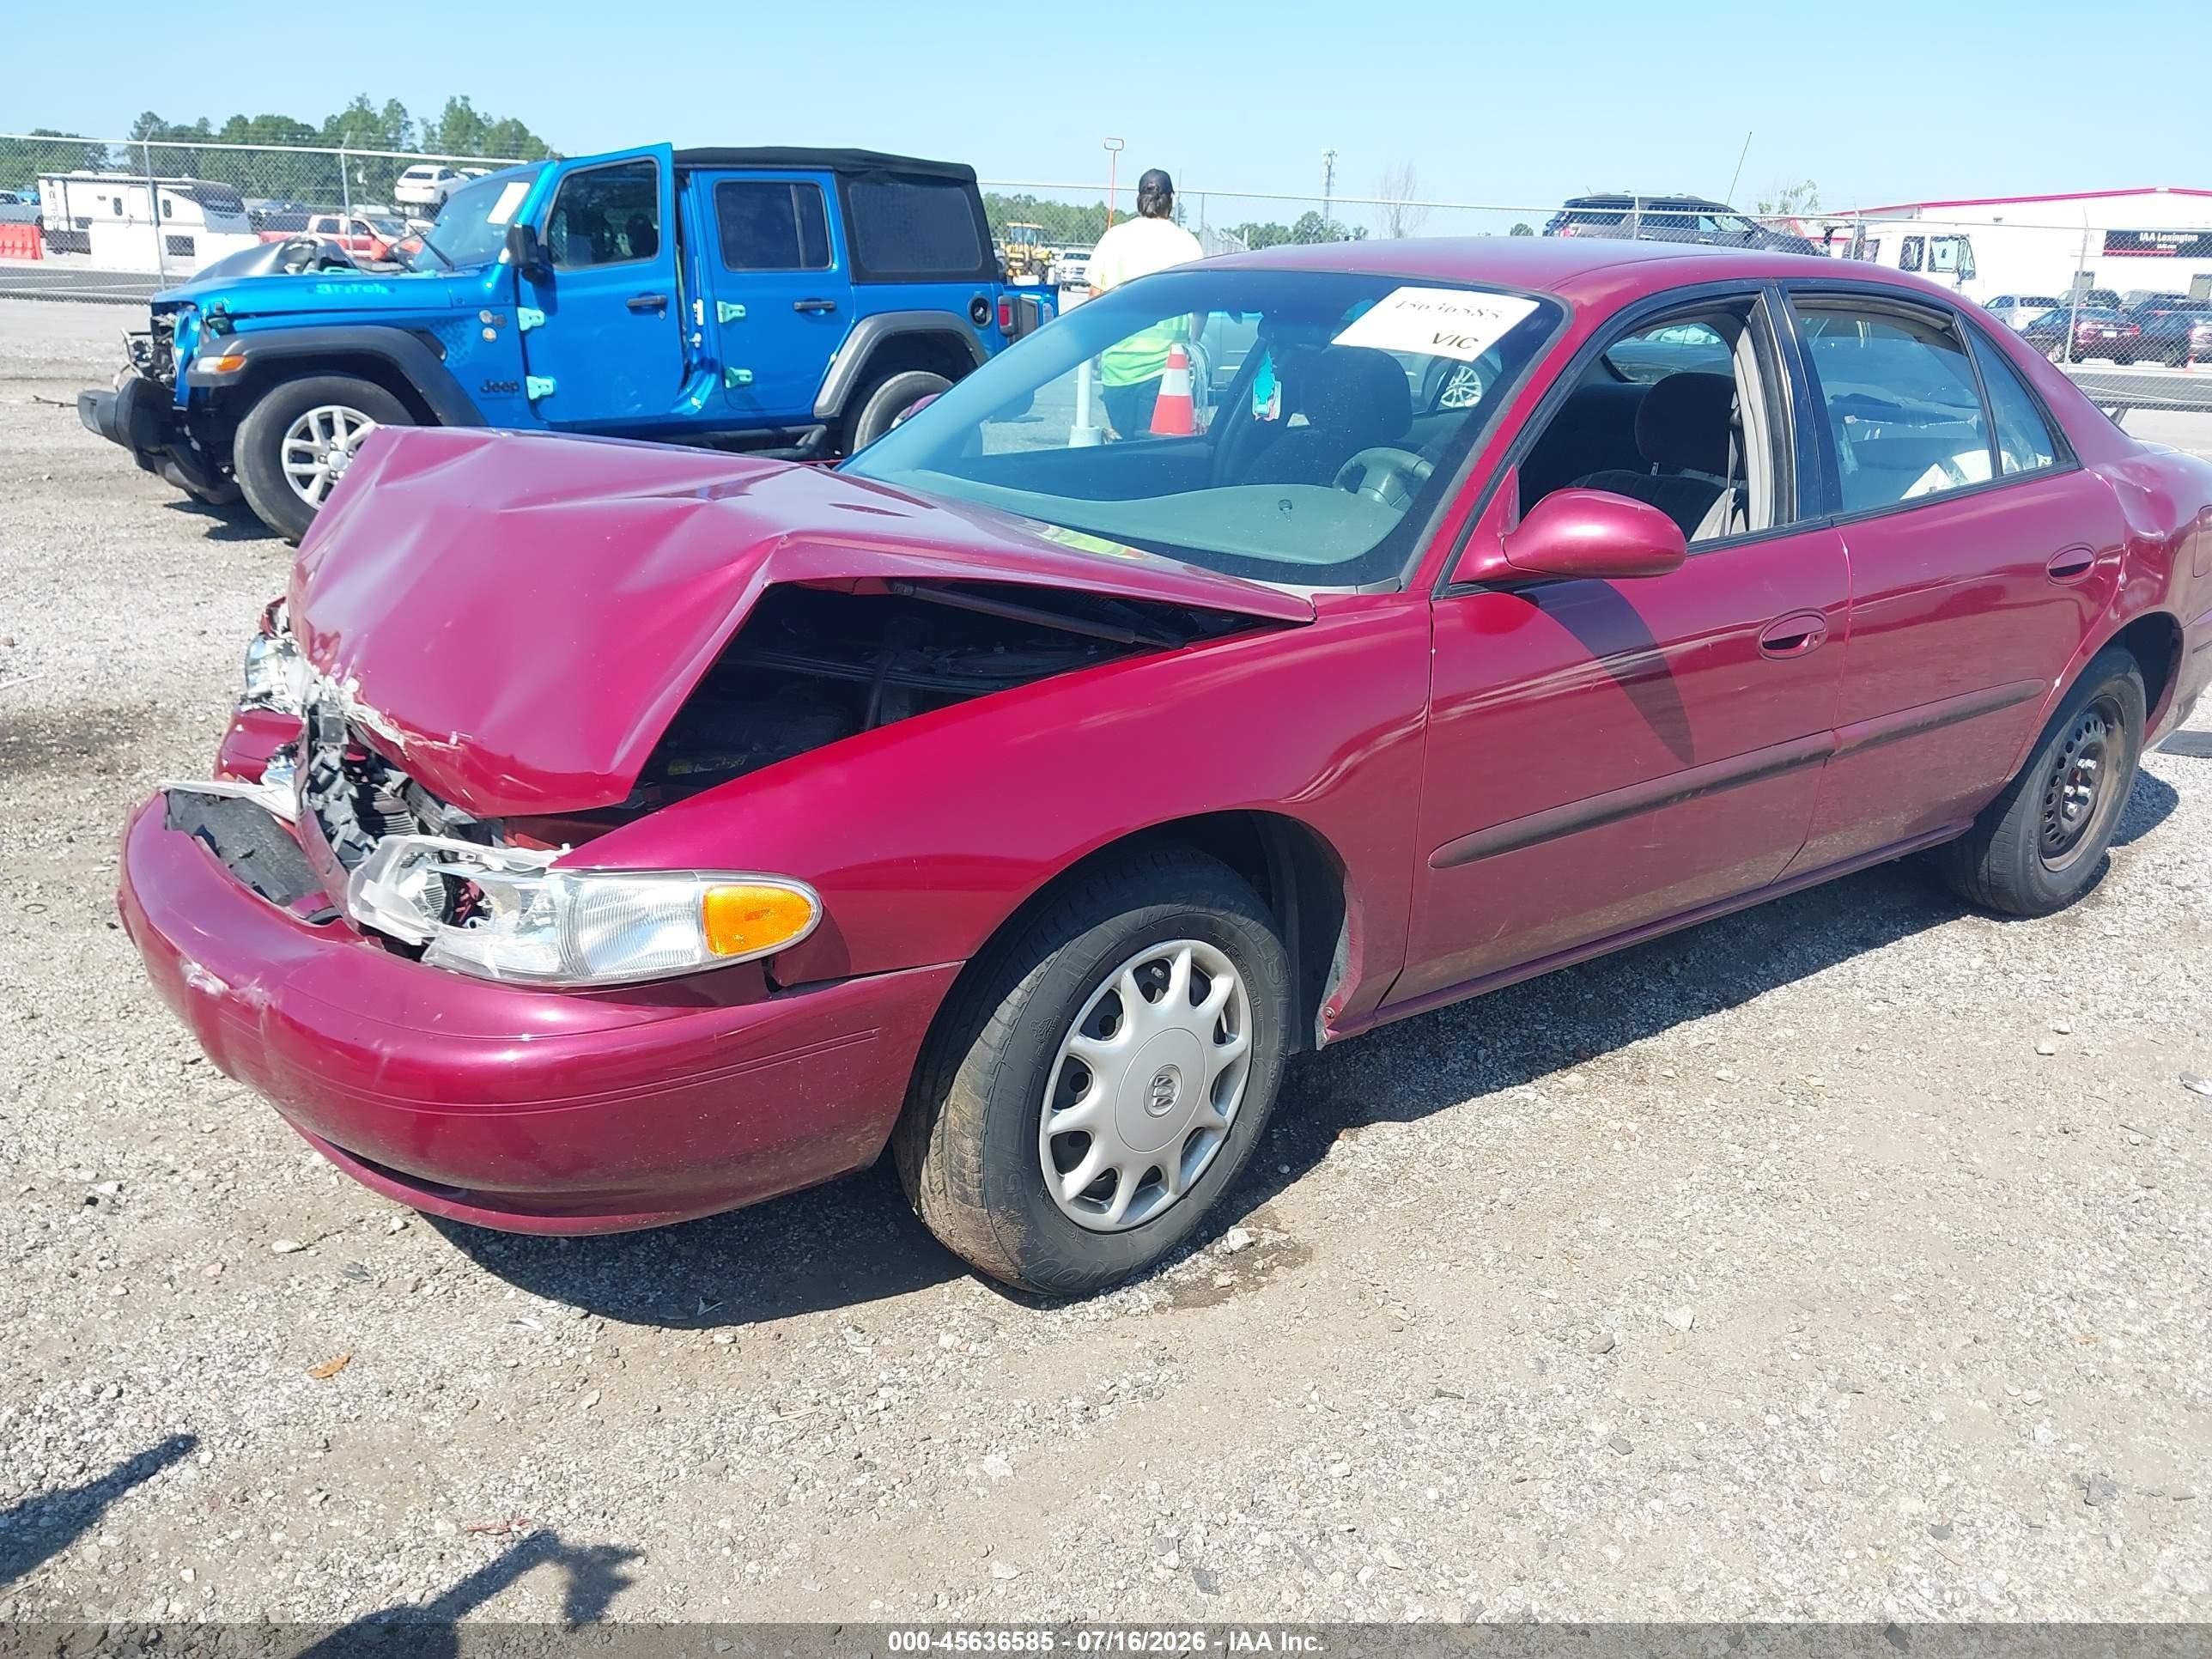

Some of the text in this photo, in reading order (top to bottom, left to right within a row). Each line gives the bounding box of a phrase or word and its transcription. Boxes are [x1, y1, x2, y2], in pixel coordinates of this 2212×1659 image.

[2139, 232, 2199, 244] IAA Lexington
[1431, 332, 1480, 349] VIC
[481, 379, 520, 394] Jeep
